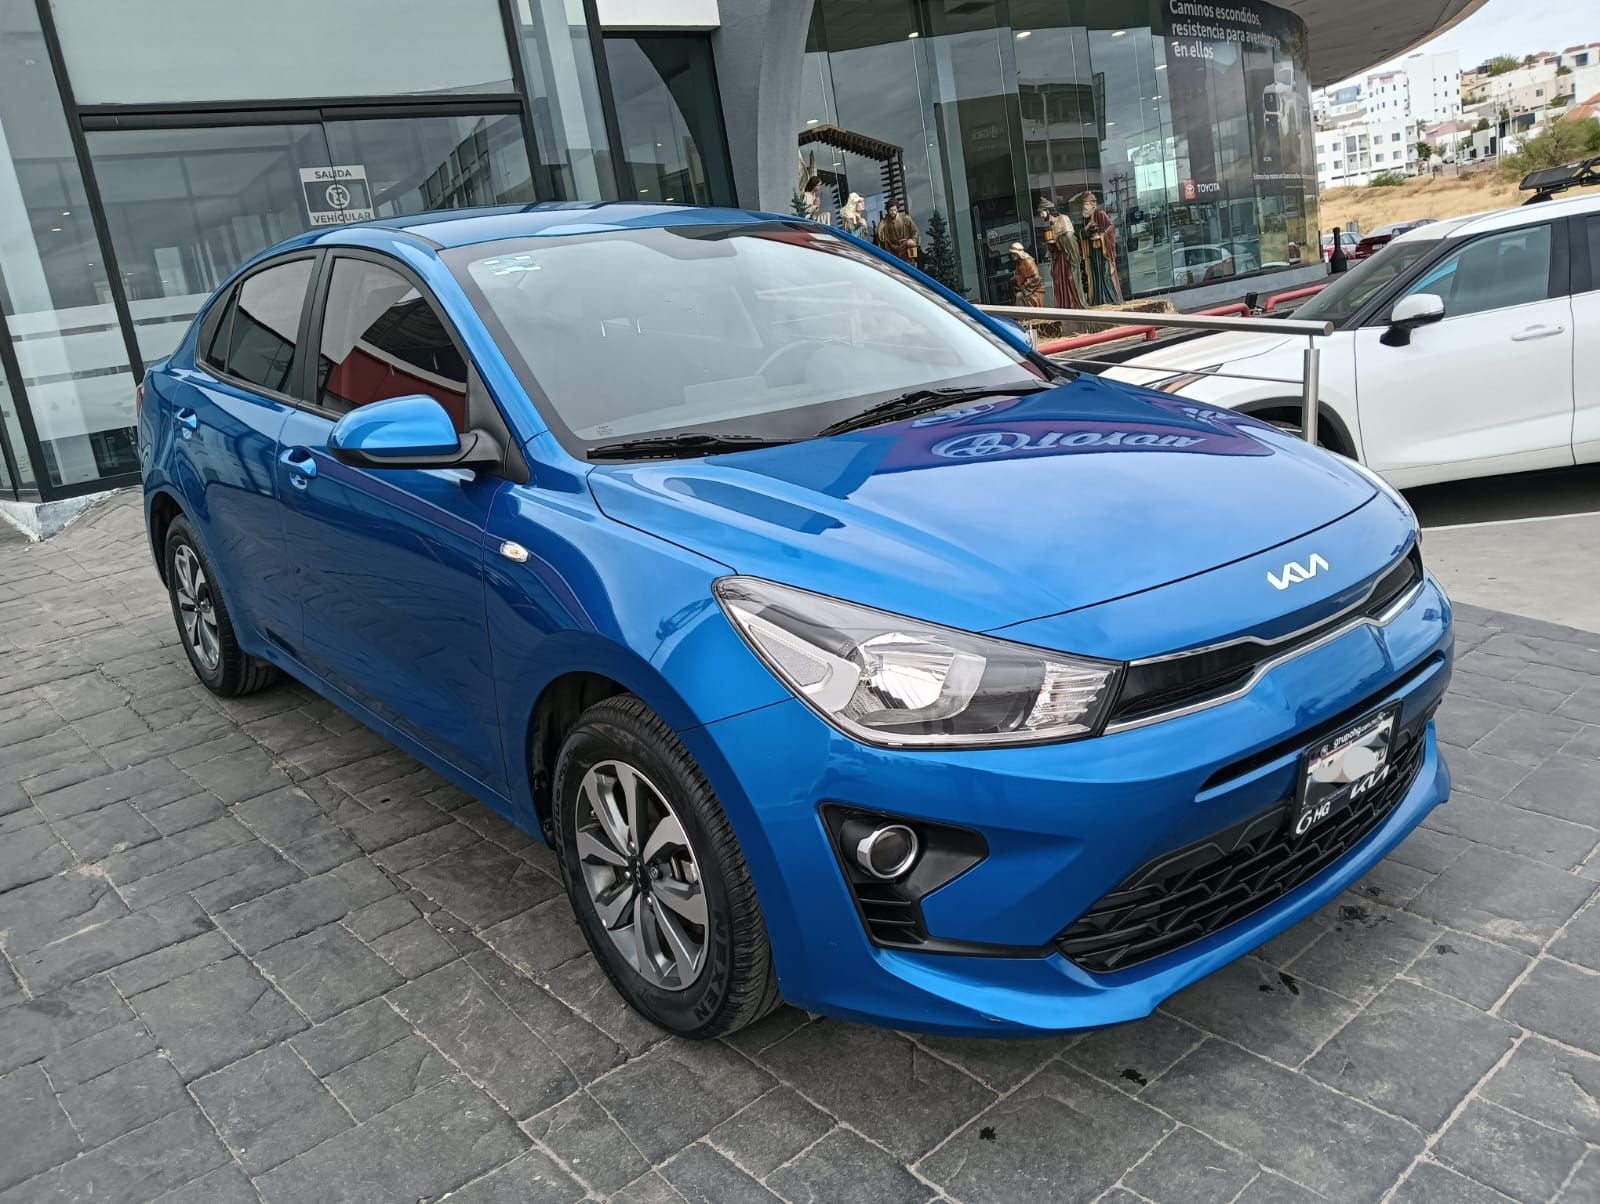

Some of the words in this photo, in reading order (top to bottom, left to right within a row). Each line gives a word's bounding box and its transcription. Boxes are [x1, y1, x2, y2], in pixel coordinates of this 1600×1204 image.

[1169, 0, 1214, 19] Caminos
[1215, 7, 1262, 28] escondidos,
[1171, 19, 1225, 39] resistencia
[1226, 28, 1245, 44] para
[1174, 43, 1188, 57] en
[1190, 41, 1214, 59] ellos
[314, 169, 353, 179] SALIDA
[1197, 183, 1221, 193] TOYOTA
[1266, 553, 1329, 591] KIA
[1350, 764, 1390, 800] KIA
